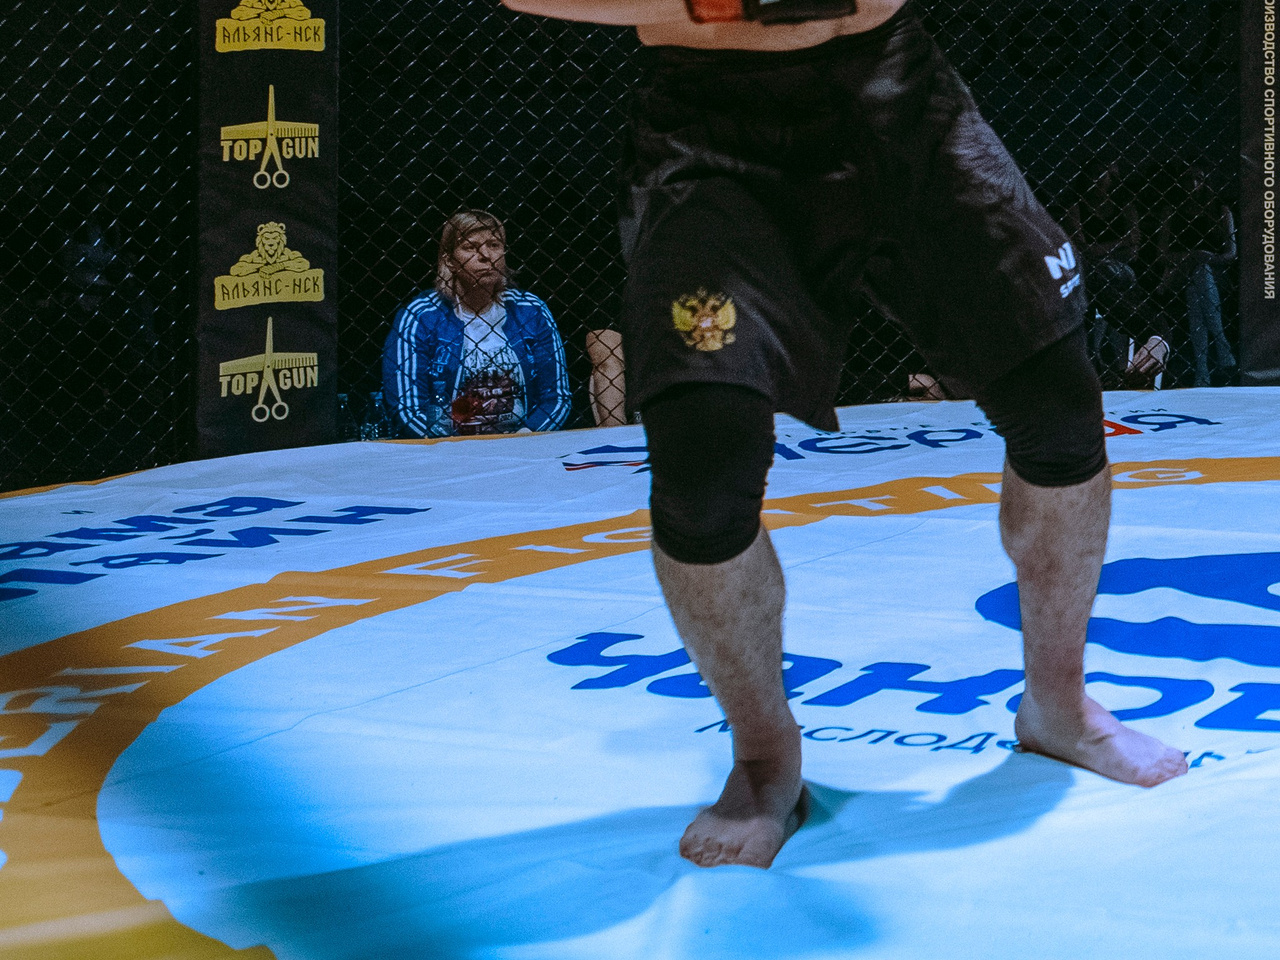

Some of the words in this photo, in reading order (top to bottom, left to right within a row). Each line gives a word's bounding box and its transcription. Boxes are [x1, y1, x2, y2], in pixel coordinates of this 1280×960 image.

[222, 25, 321, 45] АЛЬЯНС-НСК
[221, 139, 262, 162] TOP
[282, 137, 319, 160] GUN
[1263, 89, 1276, 188] СПОРТИВНОГО
[1262, 191, 1276, 300] ОБОРУДОВАНИЯ
[221, 276, 320, 302] АЛЬЯНС-НСК
[219, 373, 259, 398] TOP
[279, 366, 318, 390] GUN
[378, 464, 1203, 581] FIGTIG
